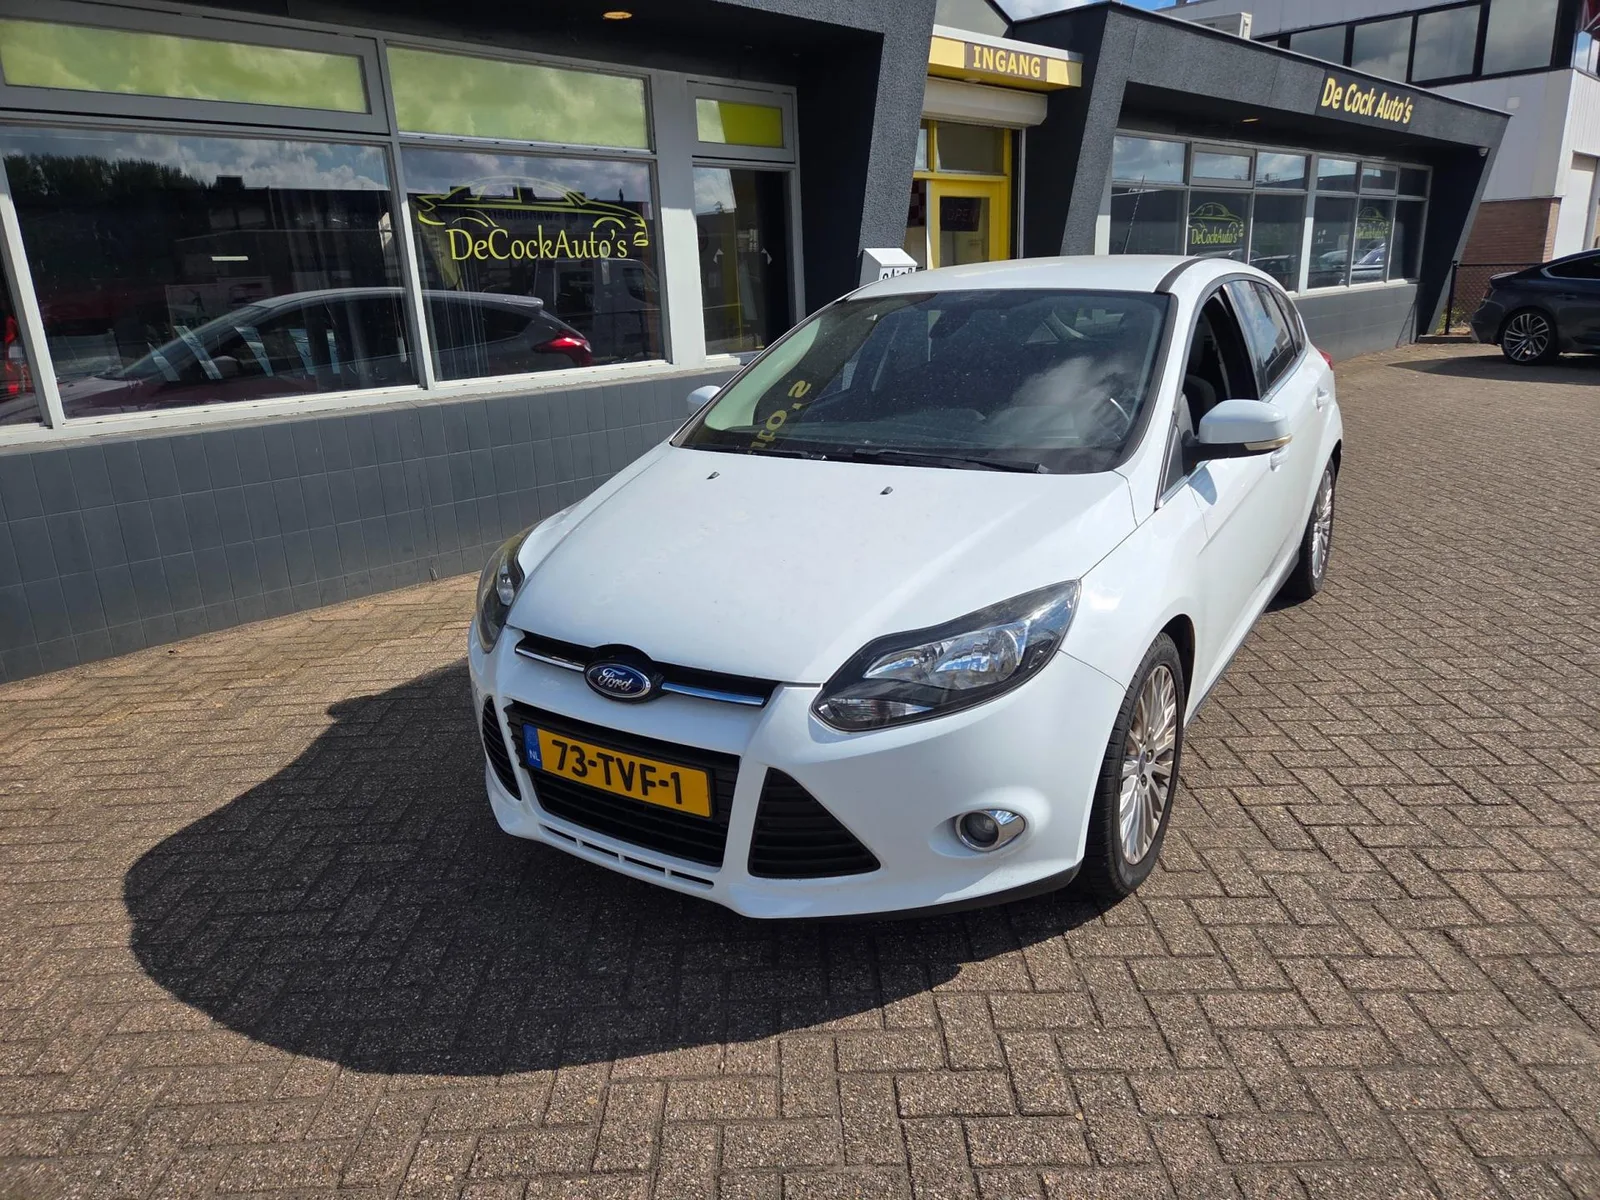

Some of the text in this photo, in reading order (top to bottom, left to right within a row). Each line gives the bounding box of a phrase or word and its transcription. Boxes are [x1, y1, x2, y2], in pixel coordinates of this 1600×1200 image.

[973, 46, 1041, 78] INGANG
[1321, 77, 1413, 124] De Cock Auto's
[445, 225, 627, 260] DeCockAuto's
[598, 667, 633, 691] Ford
[528, 749, 541, 762] NL
[552, 739, 682, 804] 73-TVF-1
